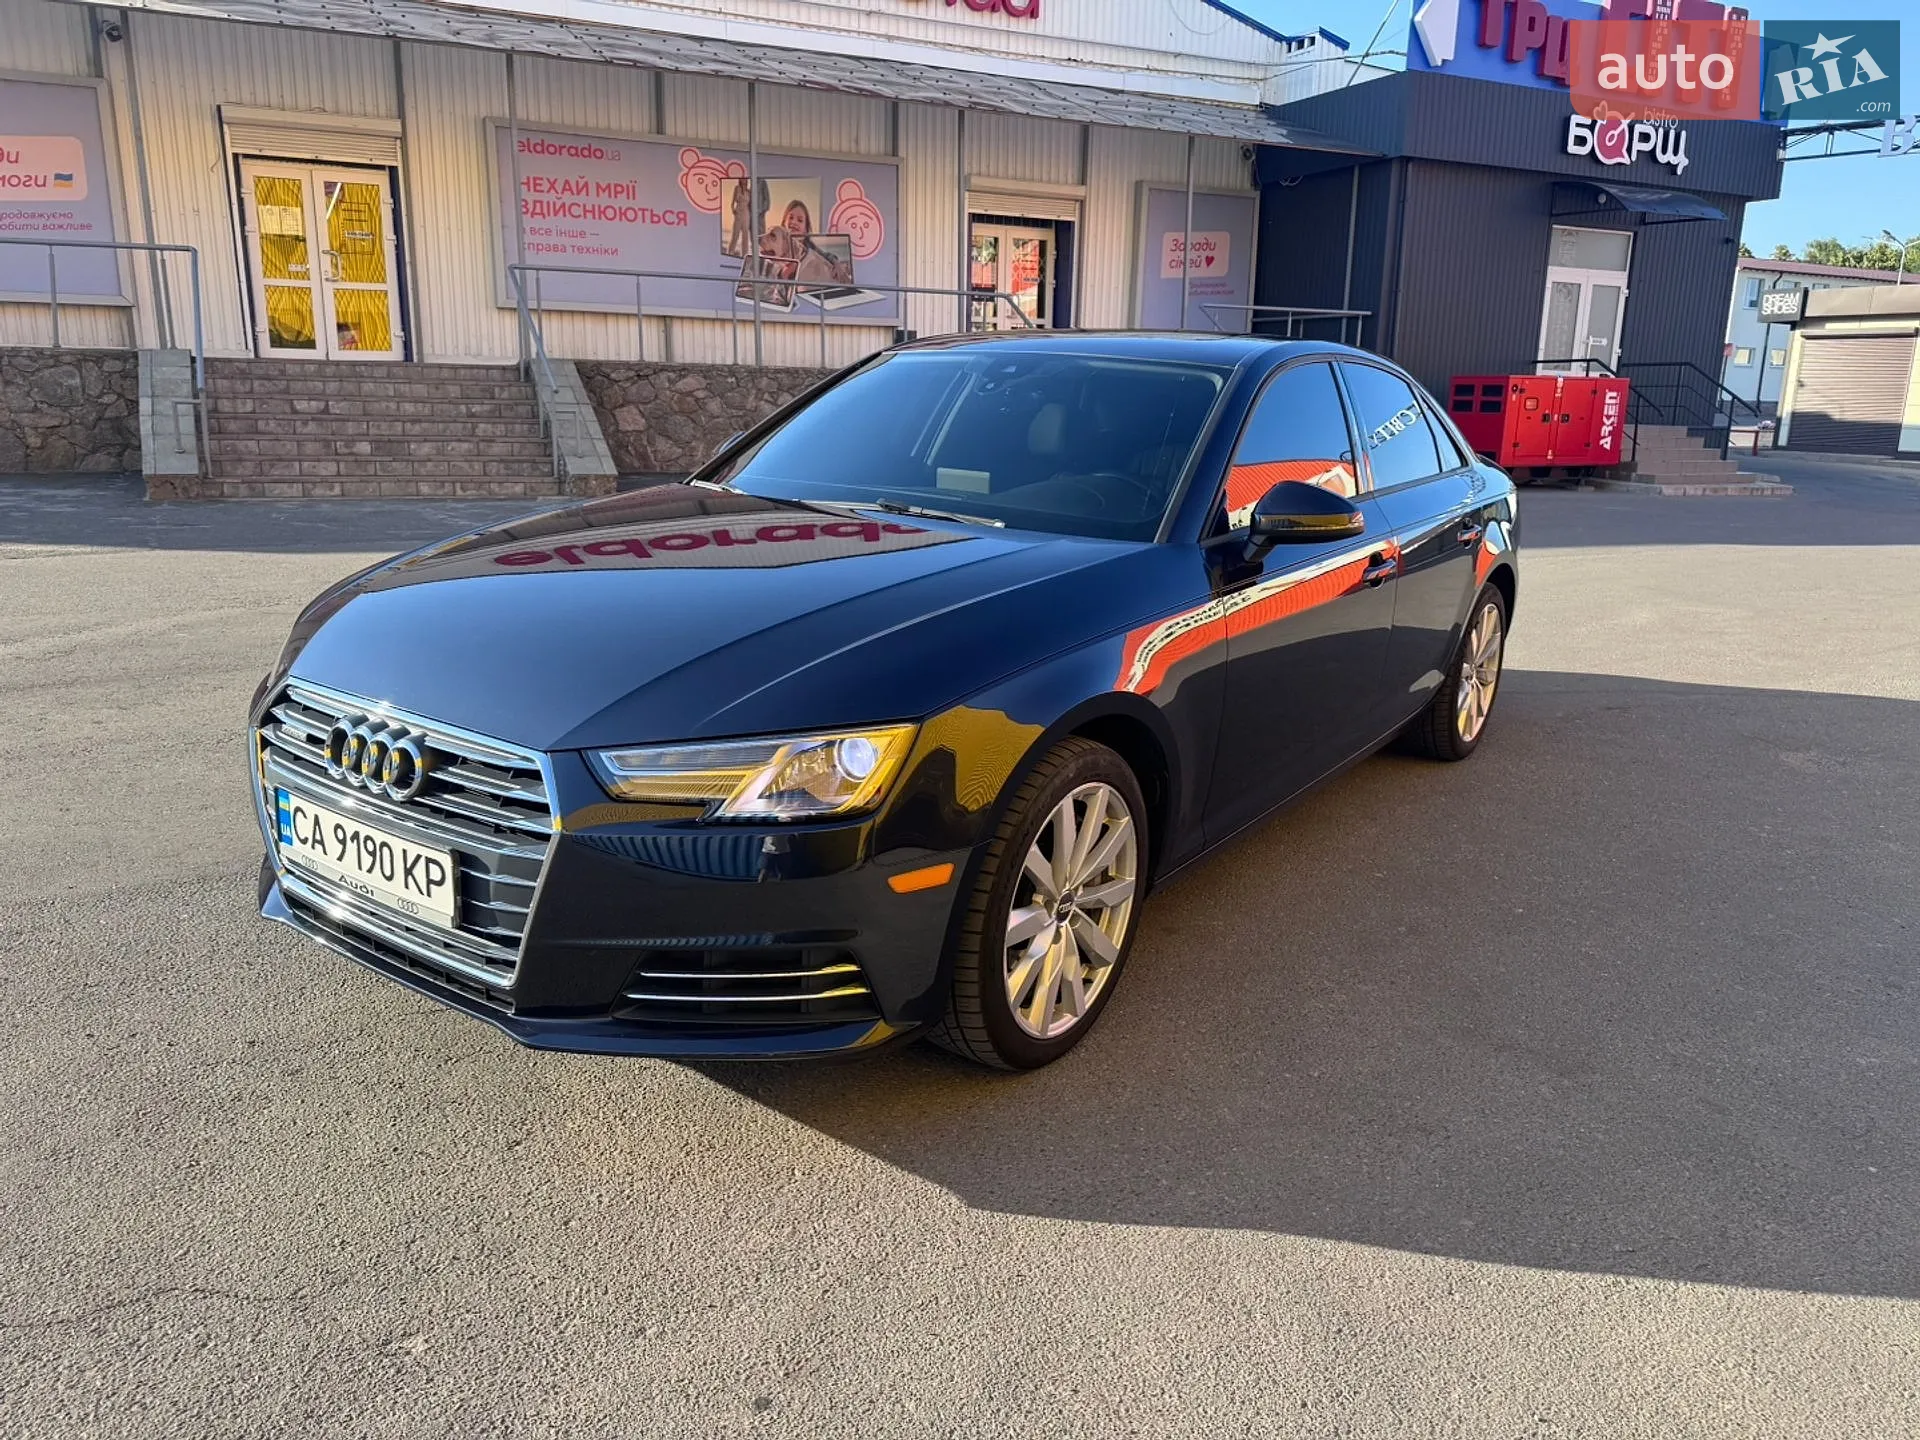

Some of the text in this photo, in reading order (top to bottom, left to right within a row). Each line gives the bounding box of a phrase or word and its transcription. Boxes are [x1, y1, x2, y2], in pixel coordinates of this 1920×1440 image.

[1643, 106, 1679, 128] bistro
[517, 138, 621, 161] eldorado.ua
[520, 175, 638, 200] НЕХАЙ МРІЇ
[521, 197, 688, 226] ЗДІЙСНЮЮТЬСЯ
[41, 222, 93, 231] важливе
[529, 226, 552, 236] все
[555, 226, 587, 239] інше
[524, 242, 619, 256] права техніки
[1763, 292, 1800, 304] DREAM
[1761, 304, 1798, 315] SHOES
[1599, 391, 1618, 451] ARKEN
[293, 805, 447, 899] CA 9190 KP
[337, 875, 375, 897] Audi
